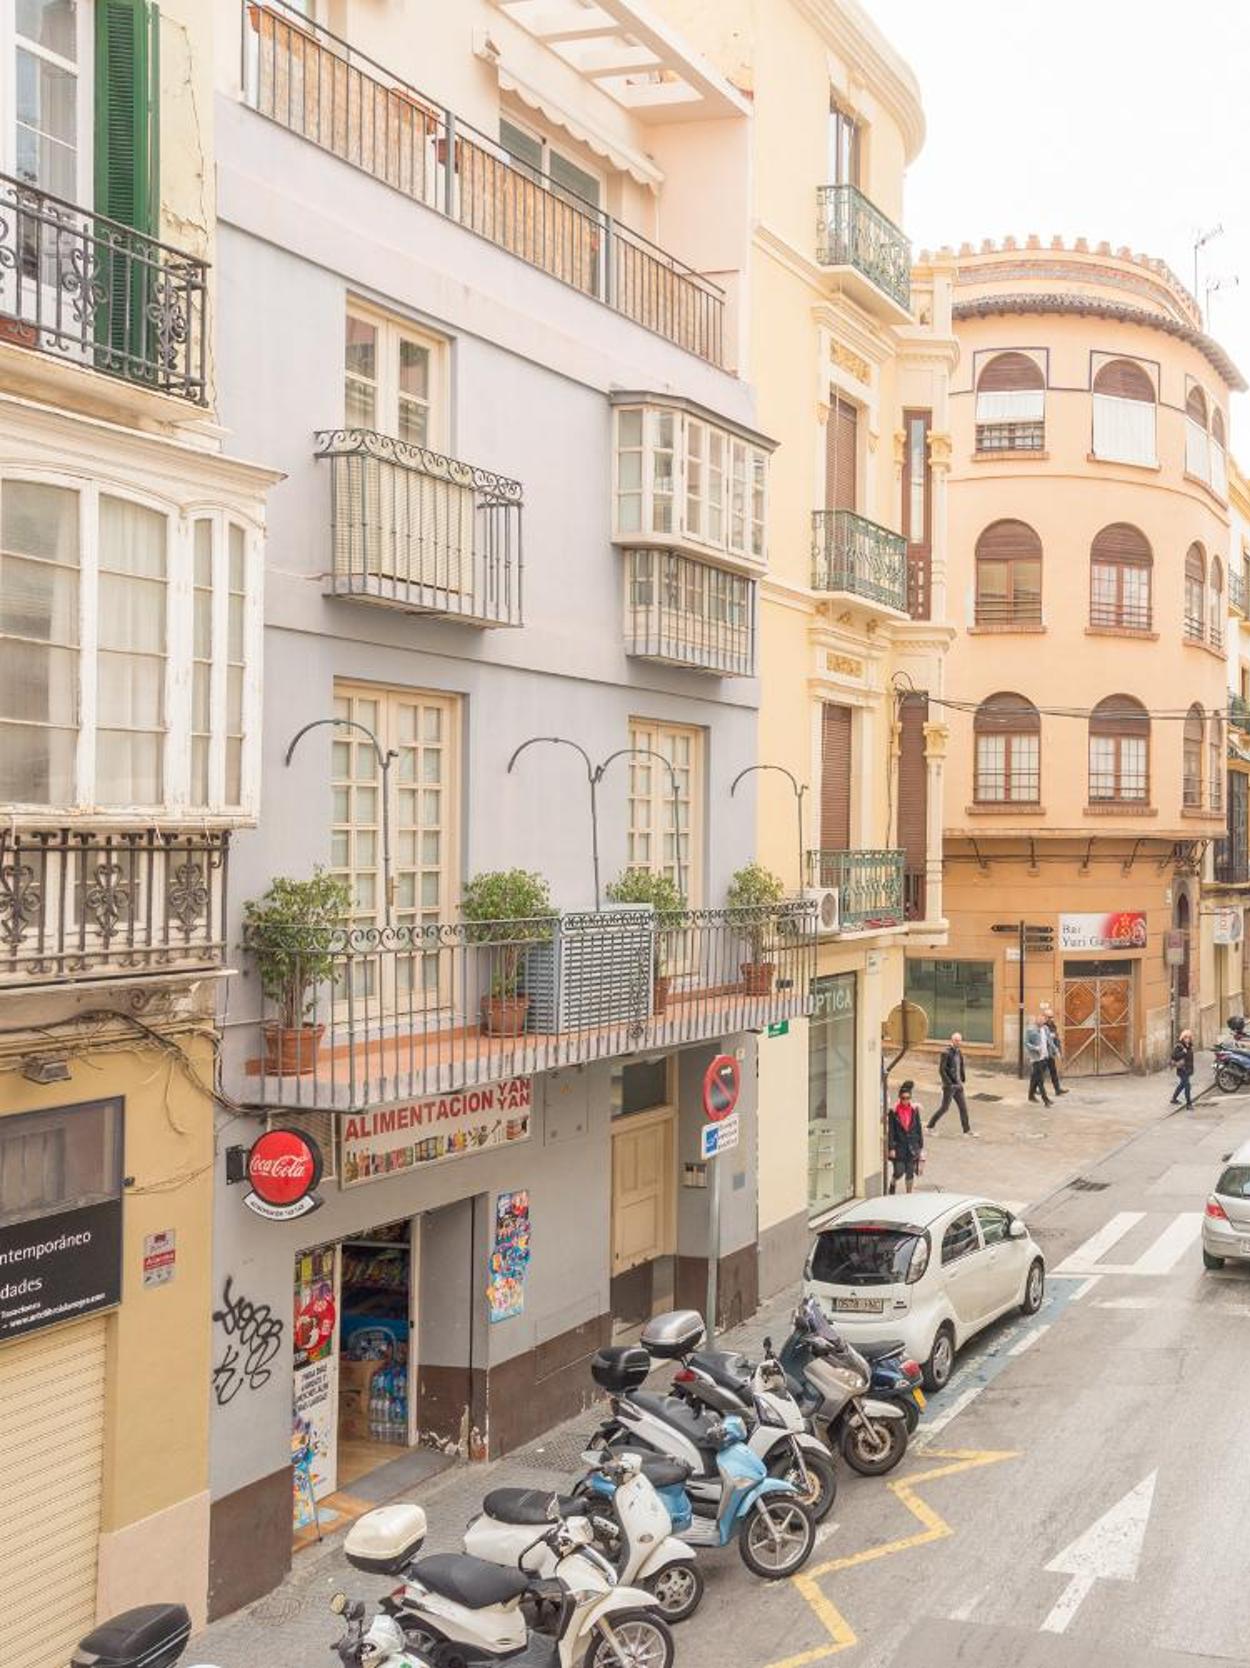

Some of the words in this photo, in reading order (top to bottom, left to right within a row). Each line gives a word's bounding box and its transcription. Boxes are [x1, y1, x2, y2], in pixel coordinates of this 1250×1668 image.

[815, 988, 852, 1013] PTICA
[344, 1089, 494, 1142] ALIMENTACION
[497, 1078, 531, 1097] YAN
[497, 1092, 531, 1111] YAN
[250, 1153, 306, 1178] Coca-Cola
